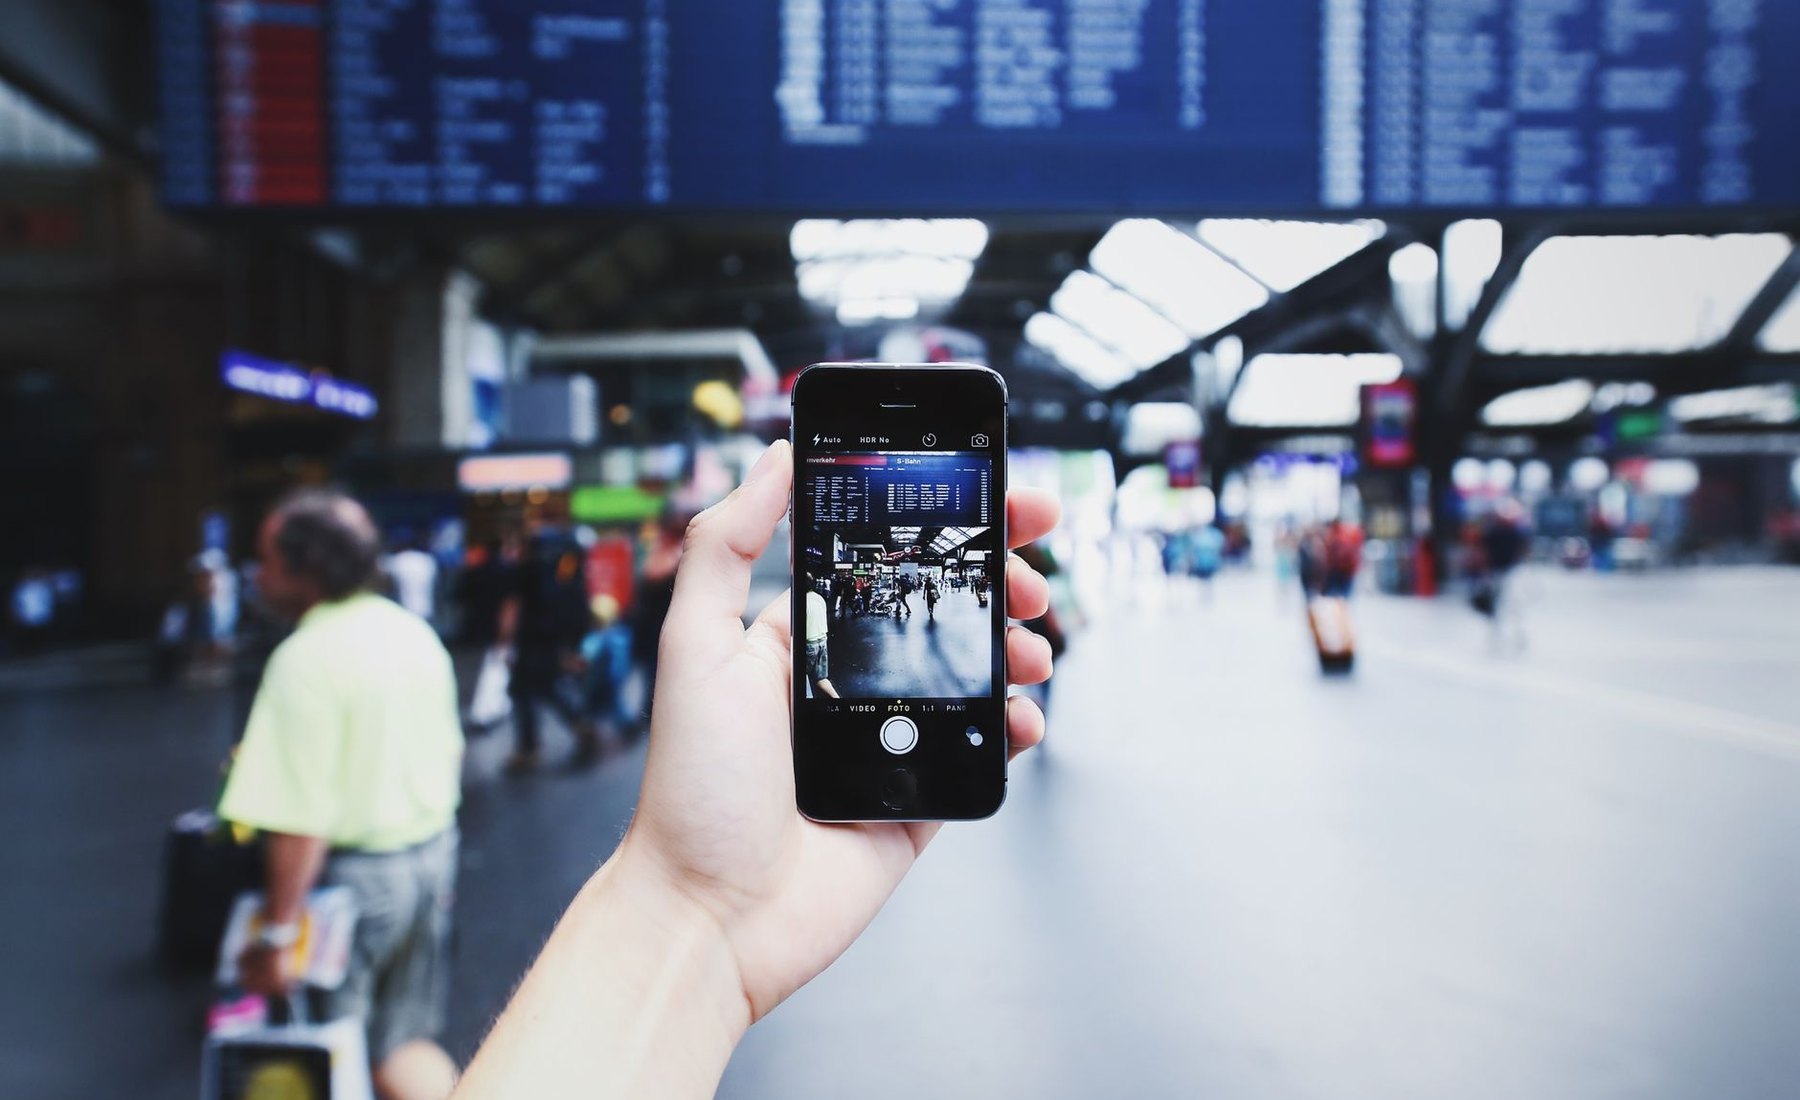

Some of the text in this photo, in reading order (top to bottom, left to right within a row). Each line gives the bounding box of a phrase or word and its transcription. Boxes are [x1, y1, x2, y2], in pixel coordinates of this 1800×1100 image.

[823, 436, 842, 444] Auto
[860, 436, 890, 444] HDR No
